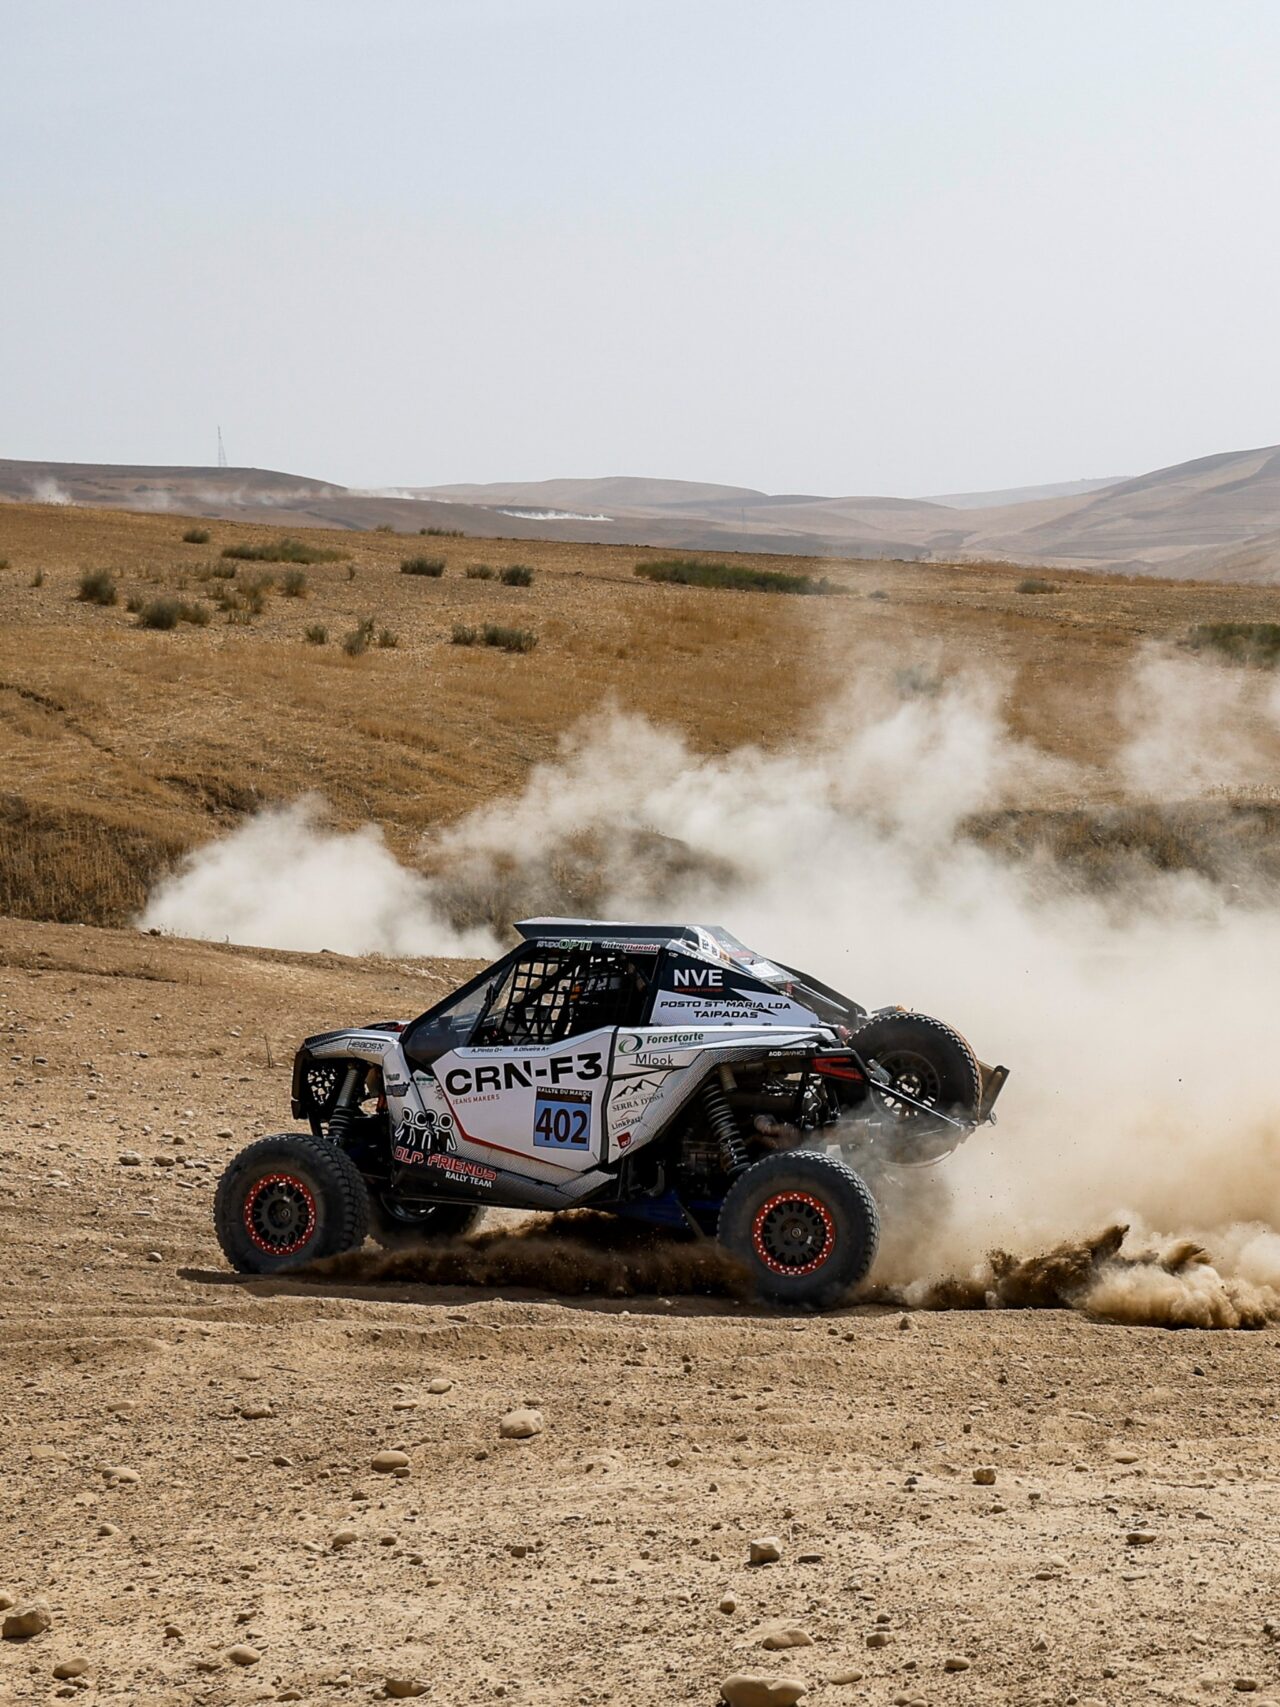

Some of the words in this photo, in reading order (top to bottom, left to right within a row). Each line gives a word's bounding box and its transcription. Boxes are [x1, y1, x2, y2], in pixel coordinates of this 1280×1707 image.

[673, 969, 723, 986] NVE
[660, 1001, 701, 1009] POSTO
[726, 1001, 765, 1009] MARIA
[768, 1002, 791, 1010] LDA
[694, 1010, 758, 1019] TAIPADAS
[646, 1032, 704, 1045] Forestcorte
[635, 1053, 674, 1066] Mlook
[445, 1052, 603, 1095] CRN-F3
[537, 1086, 558, 1095] RALLYE
[569, 1089, 592, 1097] MAROC
[453, 1096, 472, 1105] JEANS
[473, 1094, 500, 1102] MAKERS
[612, 1101, 639, 1112] SERRA
[536, 1108, 588, 1144] 402
[394, 1146, 424, 1164] OLD
[427, 1153, 497, 1181] FRIENDS
[445, 1171, 468, 1183] RALLY
[470, 1177, 492, 1188] TEAM
